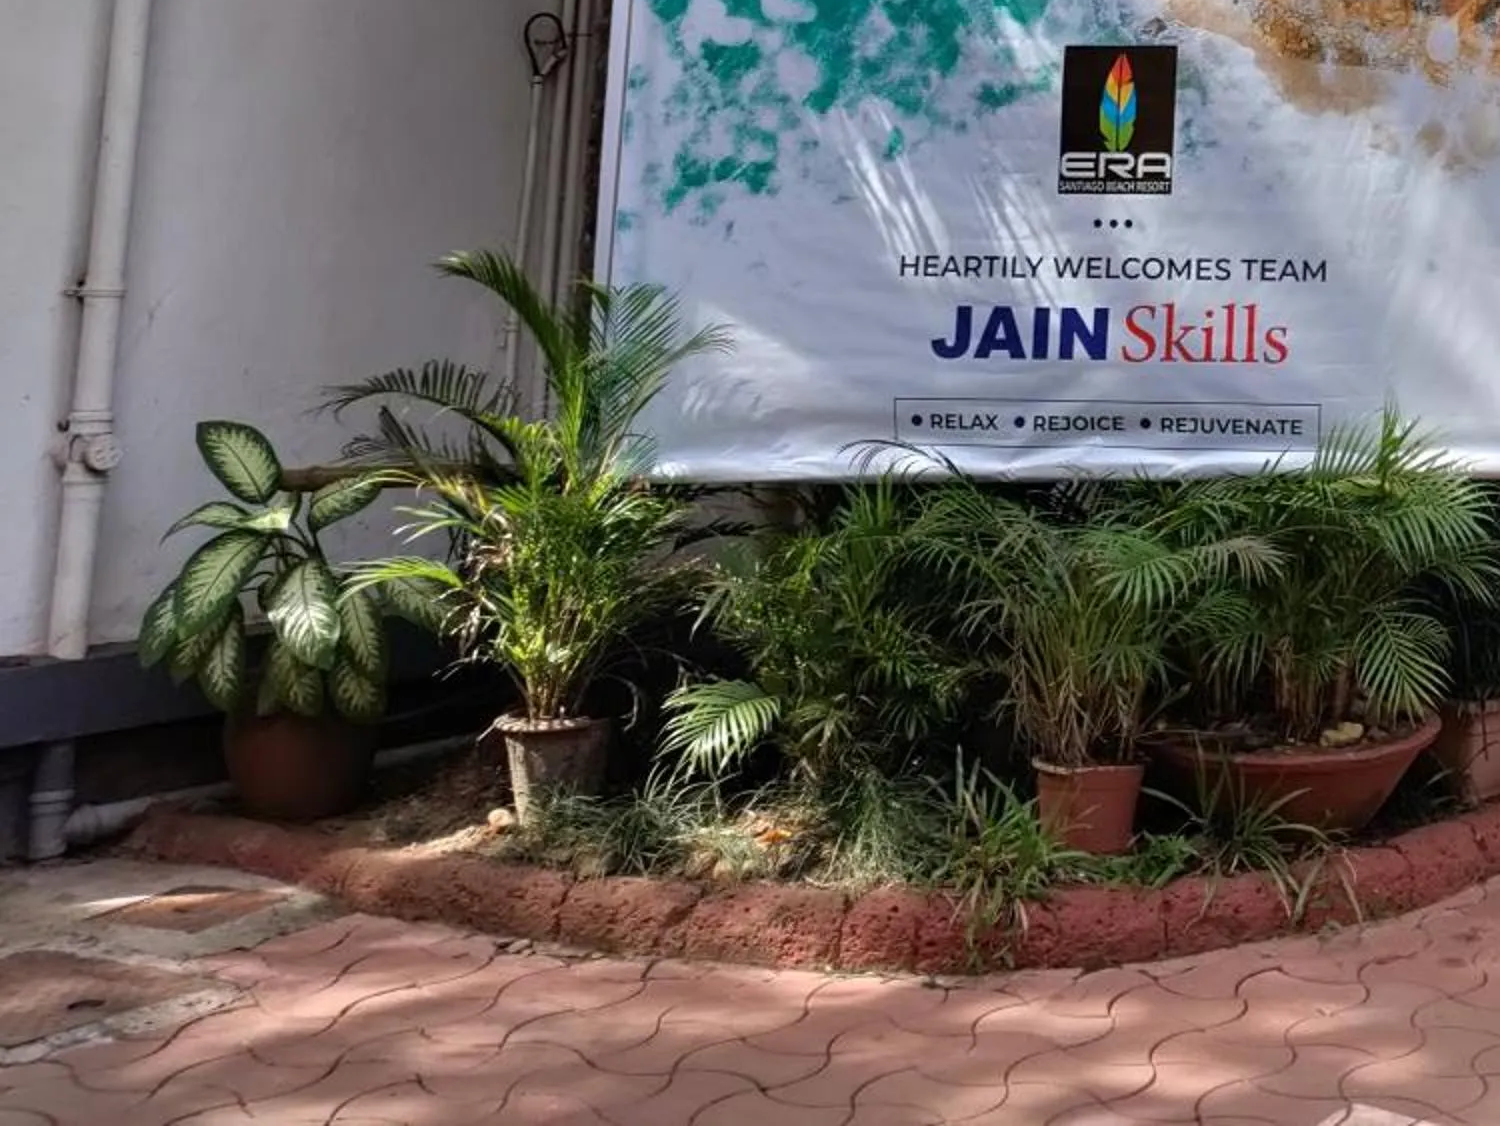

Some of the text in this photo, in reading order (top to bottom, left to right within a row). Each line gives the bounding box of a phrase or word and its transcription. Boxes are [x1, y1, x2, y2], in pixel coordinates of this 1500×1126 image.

[1061, 152, 1171, 178] ERA
[1060, 181, 1170, 192] SANTIAGO BEACH RESORT
[900, 255, 1327, 282] HEARTILY WELCOMES TEAM
[931, 302, 1289, 364] JAIN Skills
[930, 413, 1304, 436] RELAX REJOICE REJUVENATE
